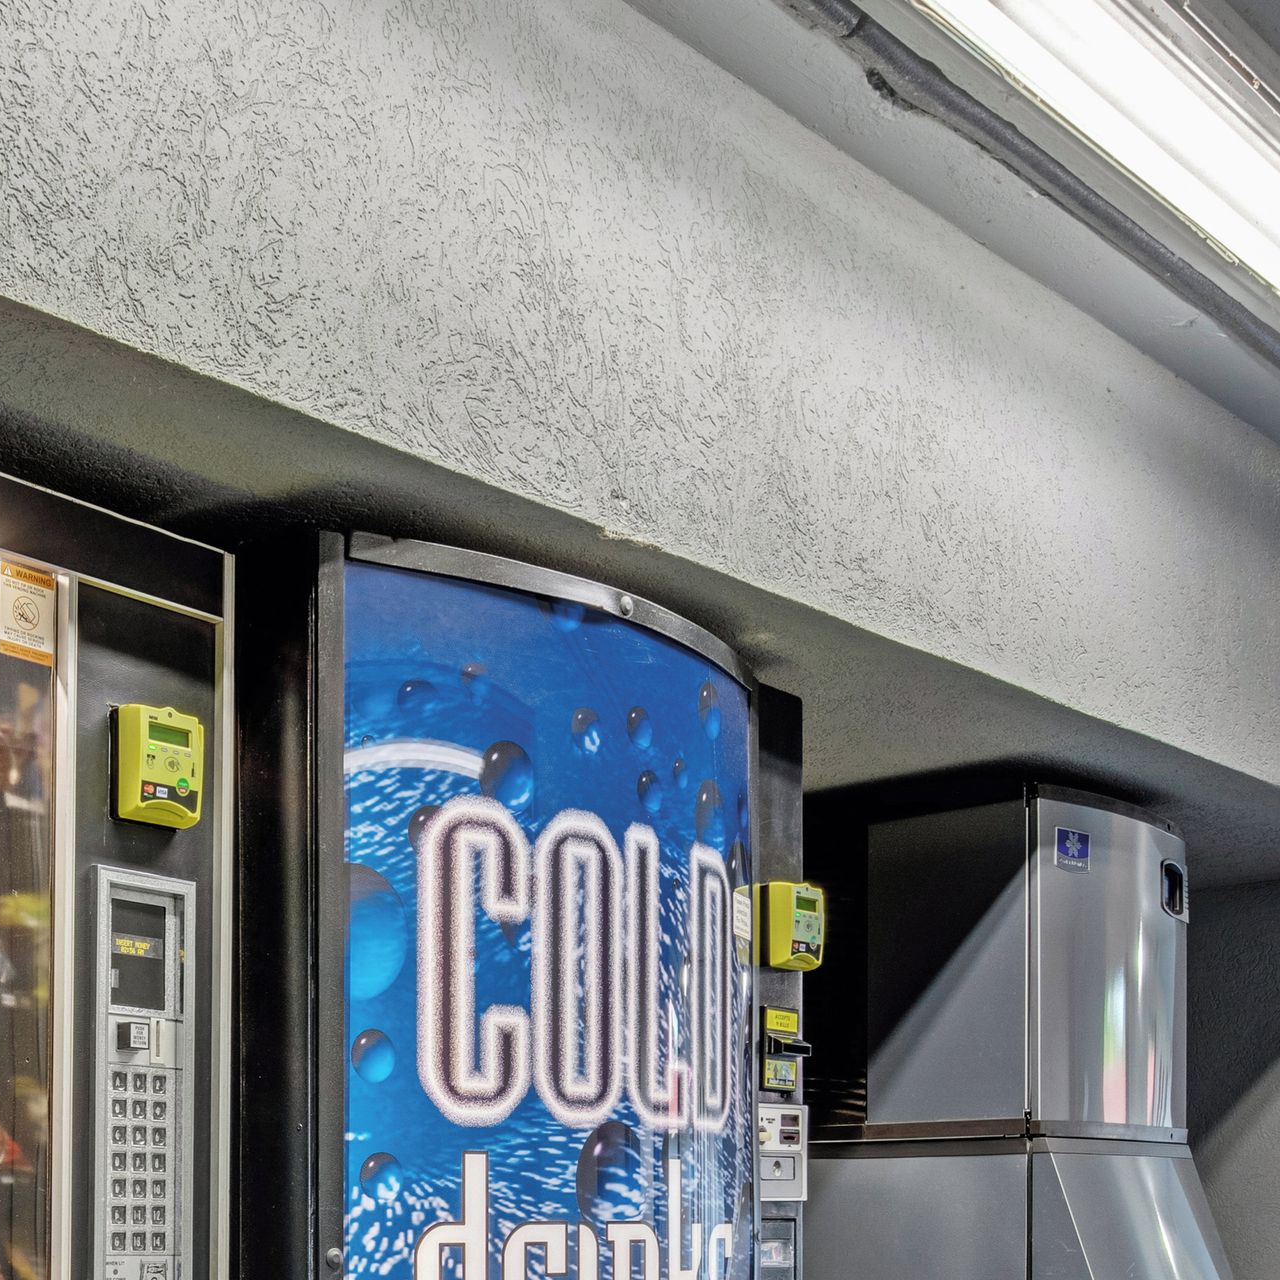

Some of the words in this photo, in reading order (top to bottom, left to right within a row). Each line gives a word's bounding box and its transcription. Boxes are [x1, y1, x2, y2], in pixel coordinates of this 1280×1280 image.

[16, 569, 52, 588] WARNING
[418, 795, 732, 1131] COLD
[153, 1209, 161, 1221] 12
